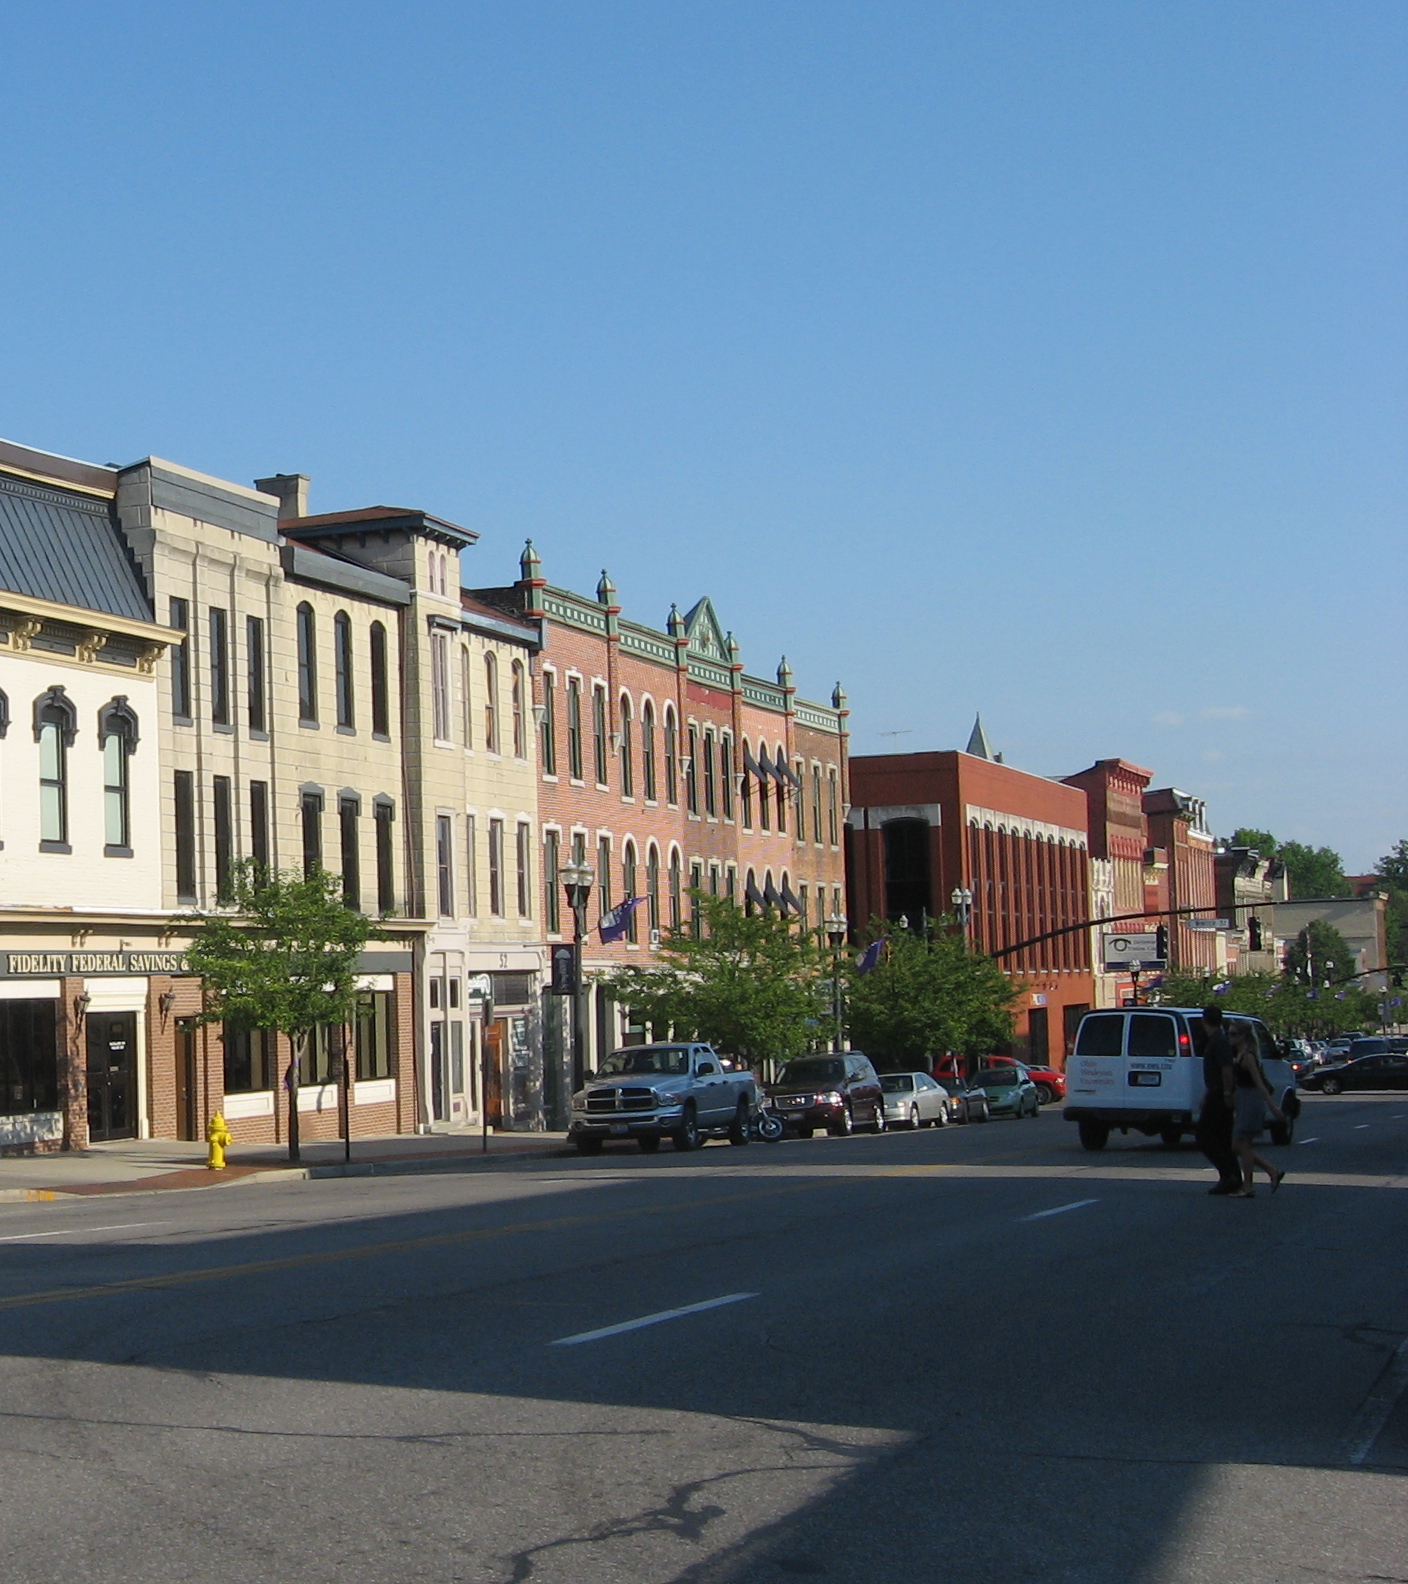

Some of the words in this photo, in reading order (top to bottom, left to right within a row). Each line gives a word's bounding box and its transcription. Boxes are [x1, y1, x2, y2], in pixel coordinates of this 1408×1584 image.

[7, 953, 66, 974] FIDELITY
[71, 953, 127, 973] FEDERAL
[129, 953, 178, 972] SAVINGS
[499, 953, 509, 968] 52
